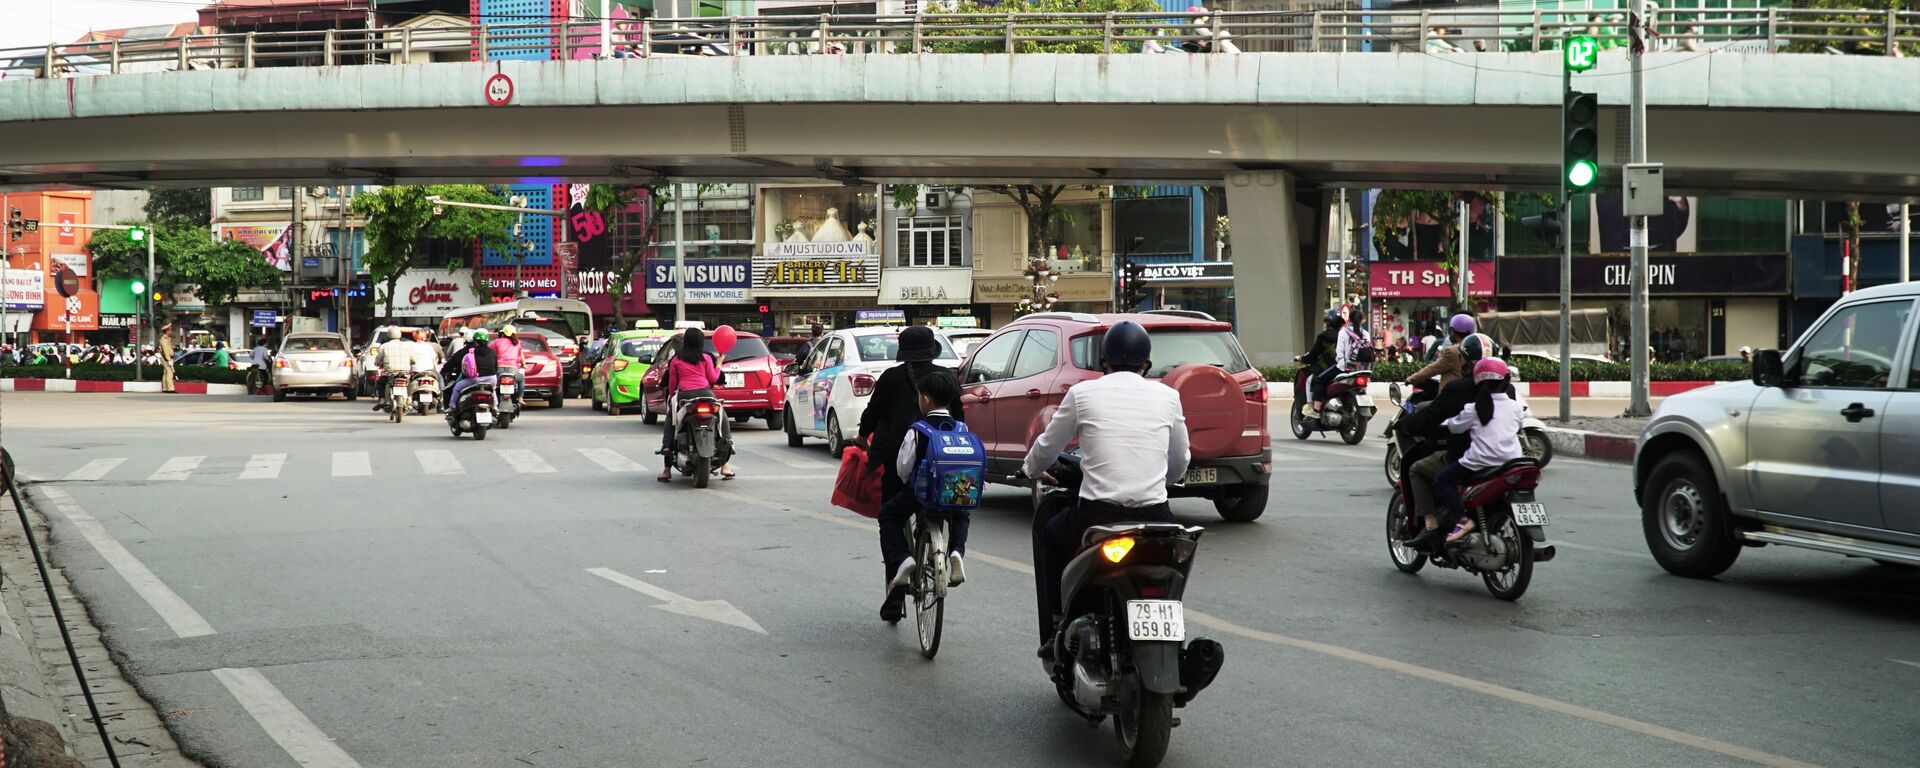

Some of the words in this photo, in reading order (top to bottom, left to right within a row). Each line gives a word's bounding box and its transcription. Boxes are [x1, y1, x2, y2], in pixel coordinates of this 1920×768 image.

[1568, 41, 1592, 66] 02
[784, 243, 863, 256] MJUSTUDIO.VN
[787, 261, 829, 269] BAKERY
[537, 275, 557, 288] MÈO
[578, 267, 604, 294] NÓN
[656, 265, 746, 283] SAMSUNG
[1388, 270, 1414, 285] TH
[1421, 269, 1475, 288] Spt
[1604, 264, 1676, 285] CHPIN
[426, 278, 459, 291] Venus
[409, 285, 453, 305] Charm
[689, 290, 711, 300] THỊNH
[714, 290, 744, 298] MOBILE
[900, 286, 947, 301] BELLA
[1712, 308, 1724, 316] 21
[102, 317, 120, 326] NAIL
[121, 317, 127, 326] &
[1136, 604, 1174, 620] 29-H1
[1133, 622, 1180, 638] 859.82
